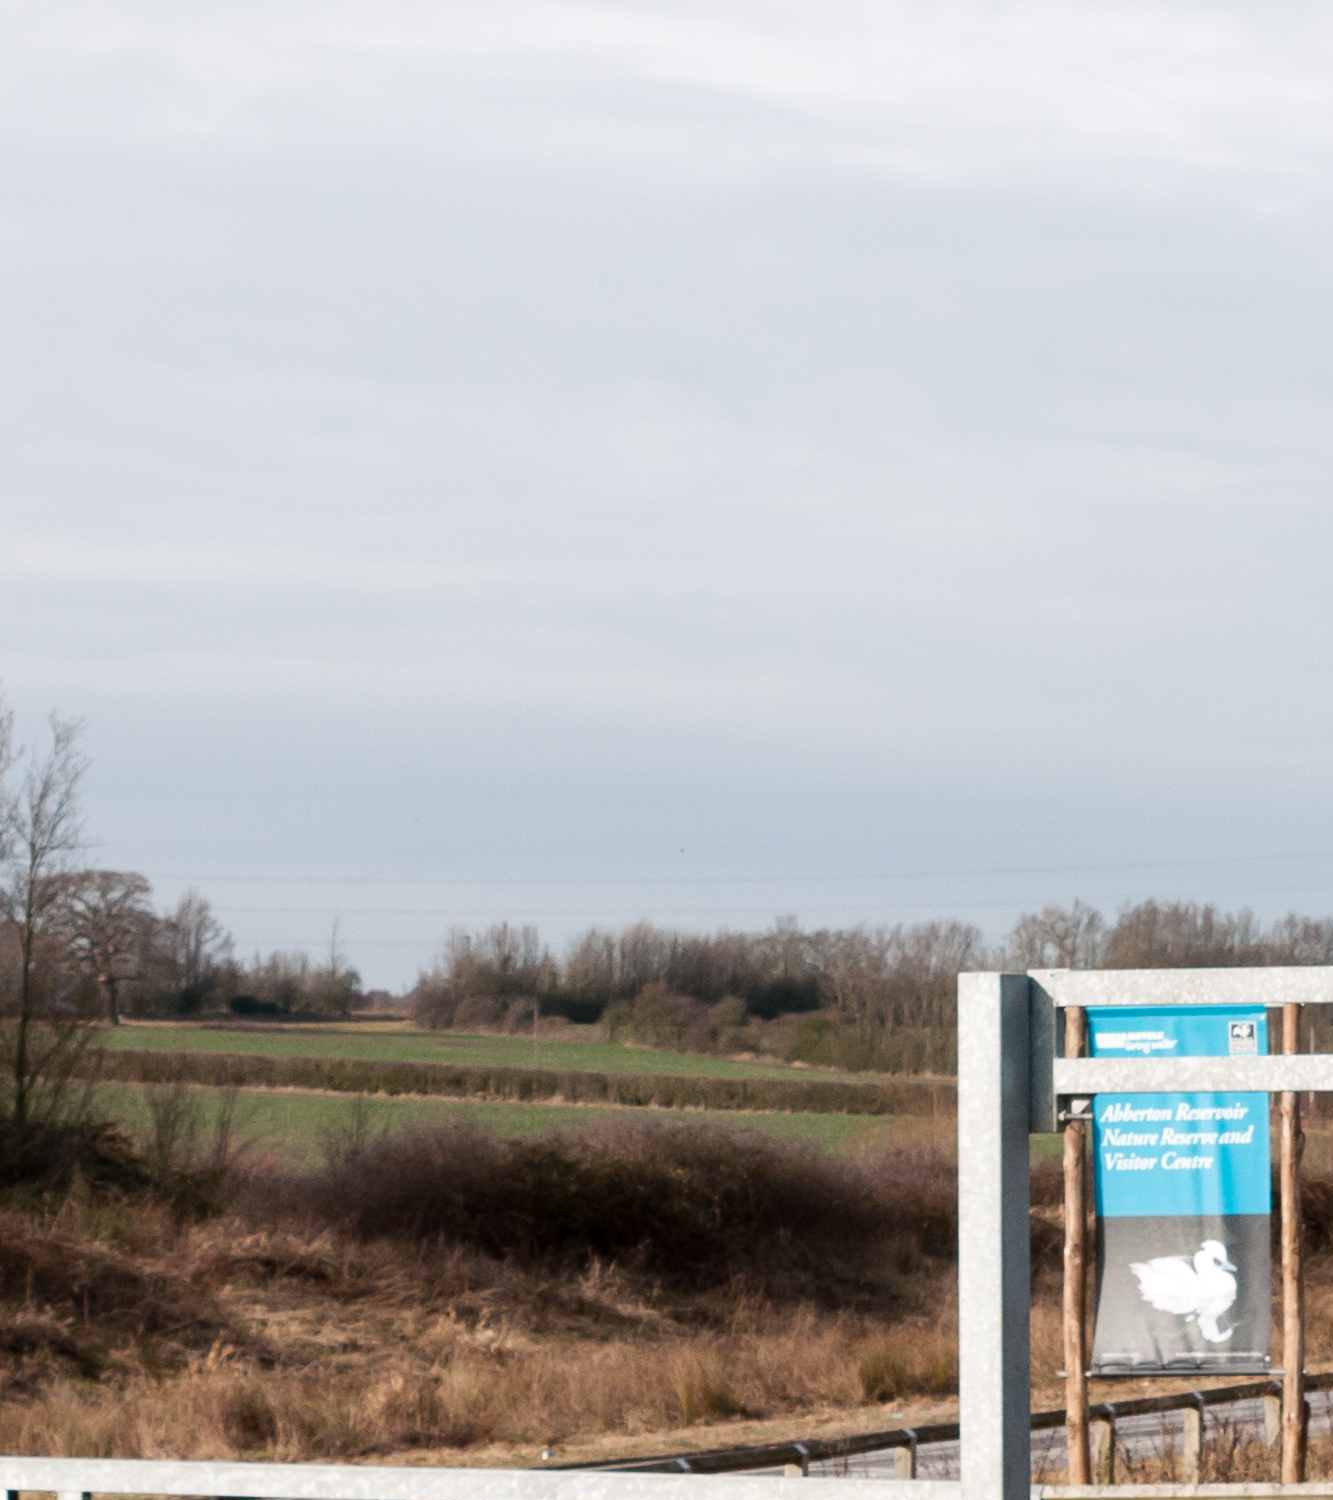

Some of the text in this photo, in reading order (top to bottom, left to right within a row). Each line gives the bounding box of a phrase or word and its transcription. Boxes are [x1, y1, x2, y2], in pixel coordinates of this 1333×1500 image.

[1100, 1102, 1249, 1122] Abberton Reservoir
[1102, 1125, 1255, 1146] Nature Reserve and
[1104, 1151, 1214, 1171] Visitor Centre
